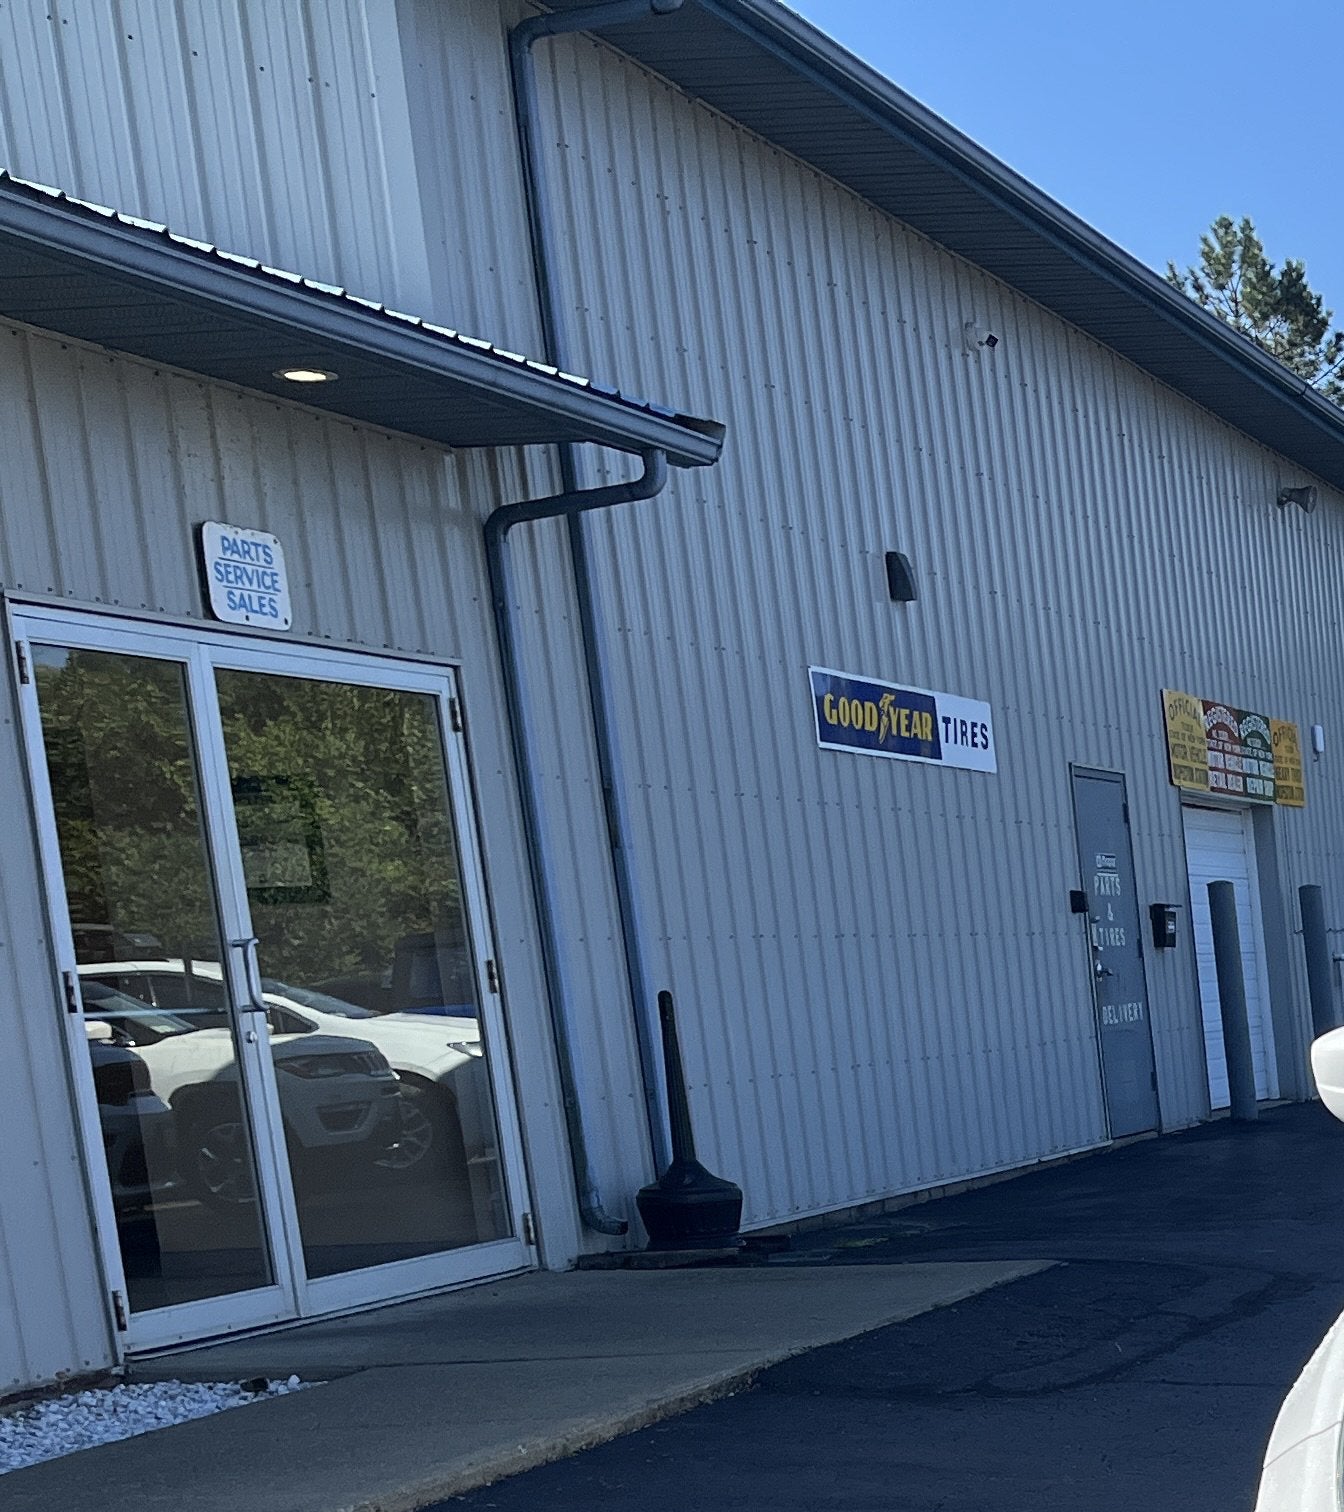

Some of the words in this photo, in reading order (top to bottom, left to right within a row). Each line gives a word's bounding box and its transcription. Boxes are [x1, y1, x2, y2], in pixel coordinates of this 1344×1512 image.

[220, 535, 274, 566] PARTS
[214, 560, 282, 593] SERVICE
[226, 589, 279, 619] SALES
[941, 715, 989, 750] TIRES
[1094, 876, 1122, 897] PARTS
[1107, 902, 1114, 921] &
[1098, 927, 1126, 947] TIRES
[1102, 1002, 1144, 1026] DELIVERY
